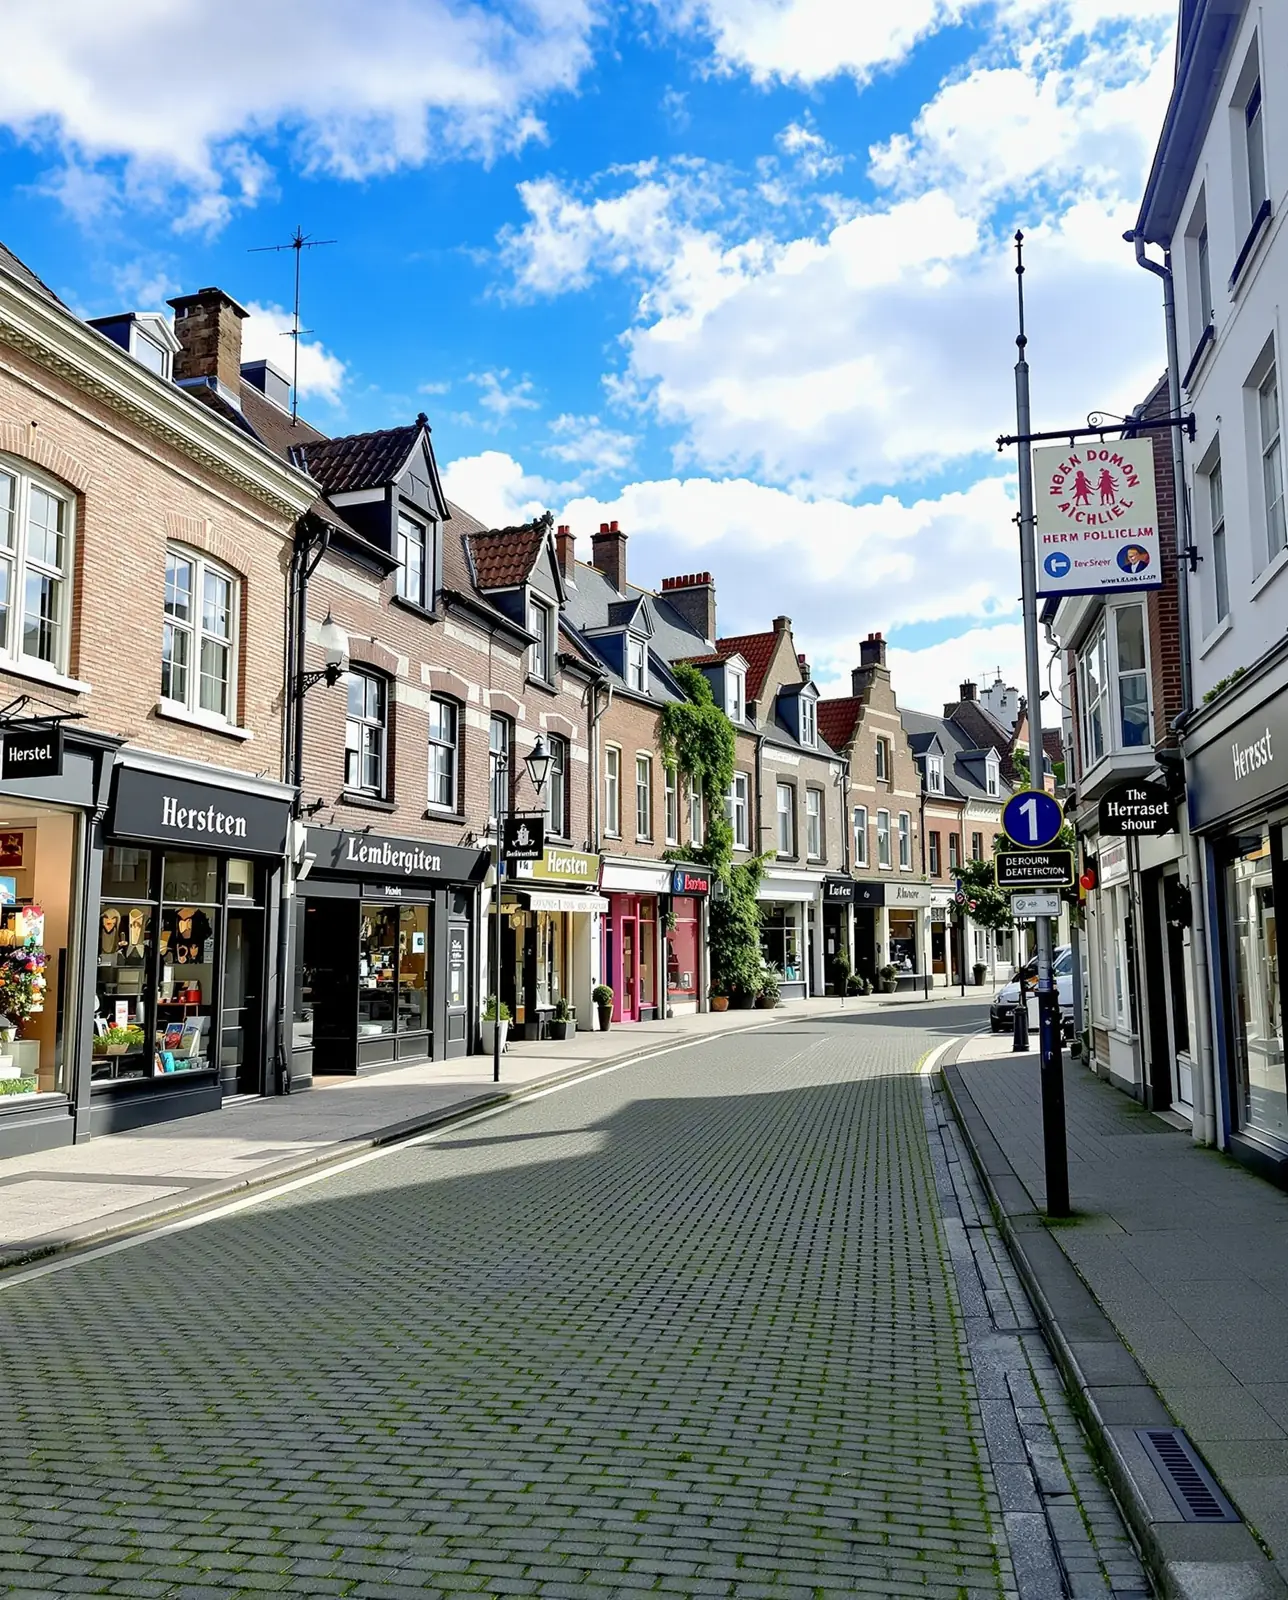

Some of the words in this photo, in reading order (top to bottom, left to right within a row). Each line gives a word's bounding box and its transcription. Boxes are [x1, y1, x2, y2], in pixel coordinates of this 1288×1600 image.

[1087, 450, 1140, 488] DOMON
[1043, 533, 1079, 543] HERM
[1126, 789, 1148, 801] The
[1107, 801, 1170, 817] Herraset
[1018, 798, 1039, 841] 1
[1121, 819, 1157, 831] shour
[547, 851, 588, 876] Hersten
